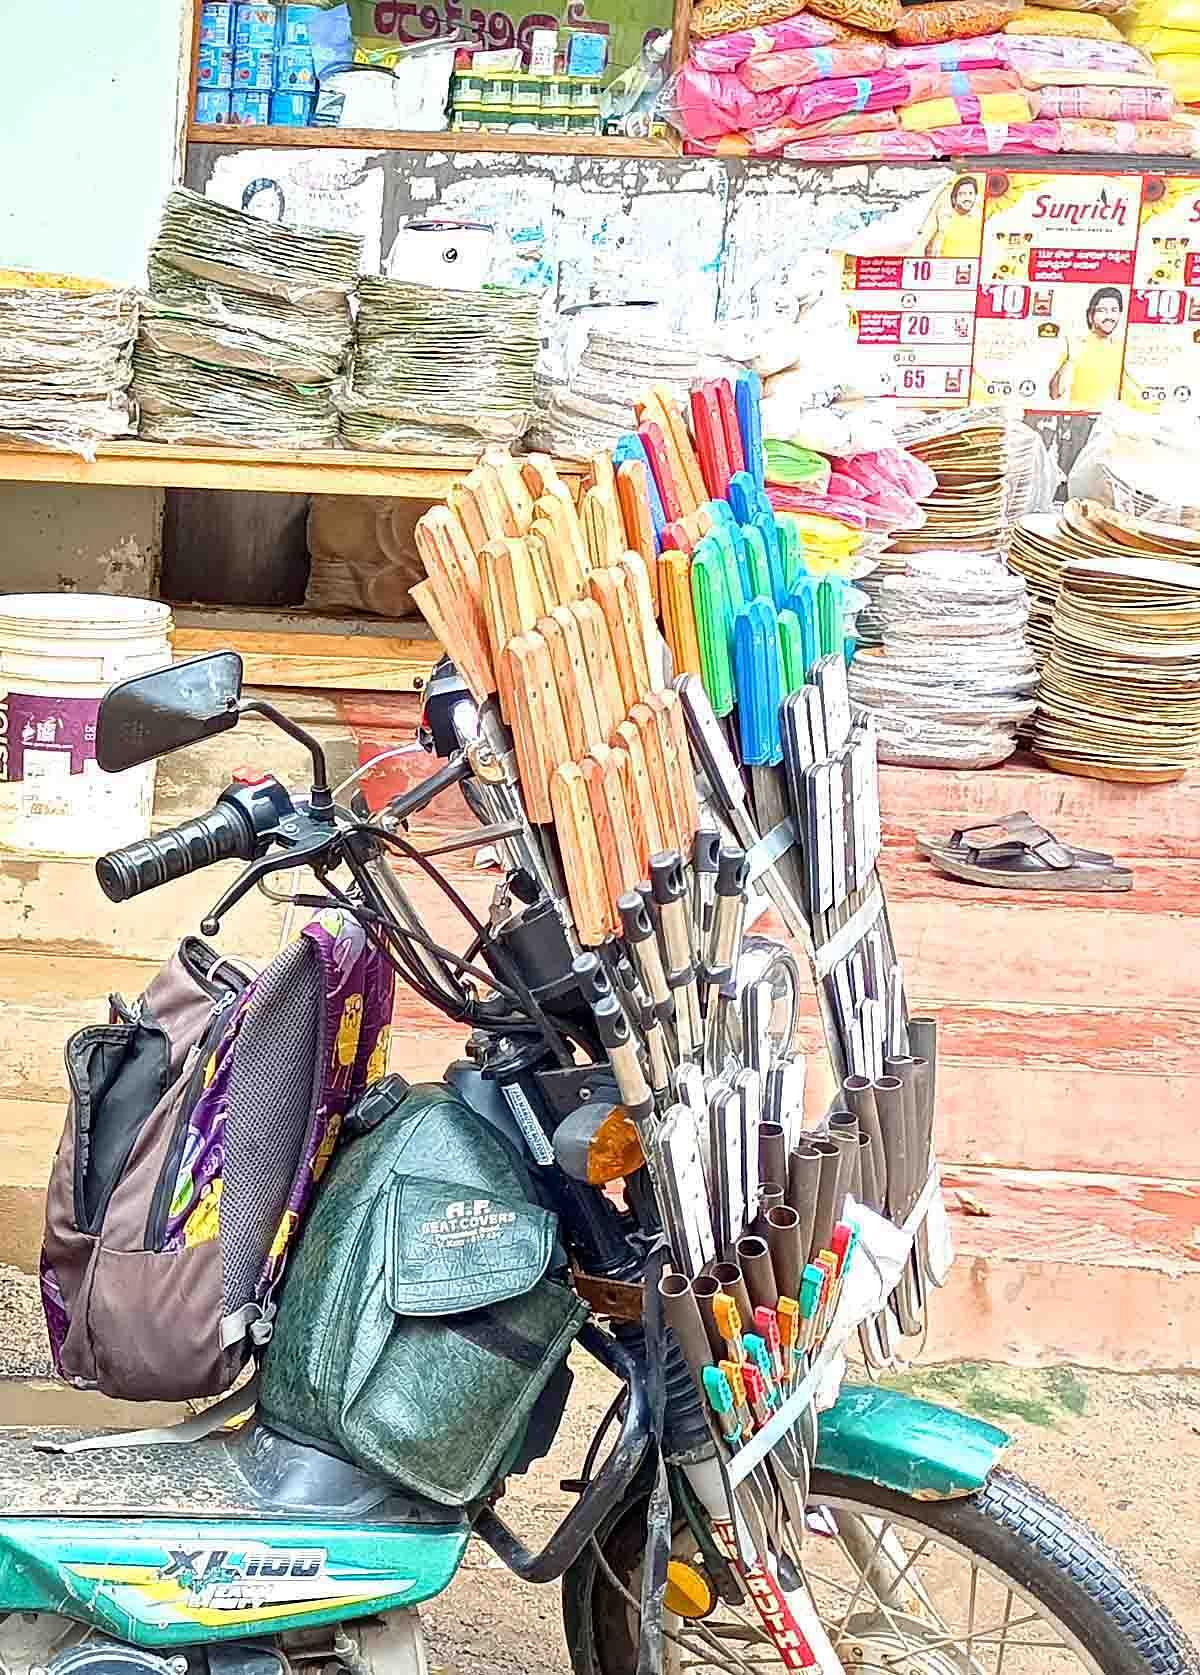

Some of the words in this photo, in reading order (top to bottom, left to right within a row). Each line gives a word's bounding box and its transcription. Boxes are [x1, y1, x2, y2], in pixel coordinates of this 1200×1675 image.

[1031, 194, 1128, 226] Sunrich
[912, 261, 931, 280] 10
[907, 316, 929, 336] 20
[903, 370, 926, 388] 65
